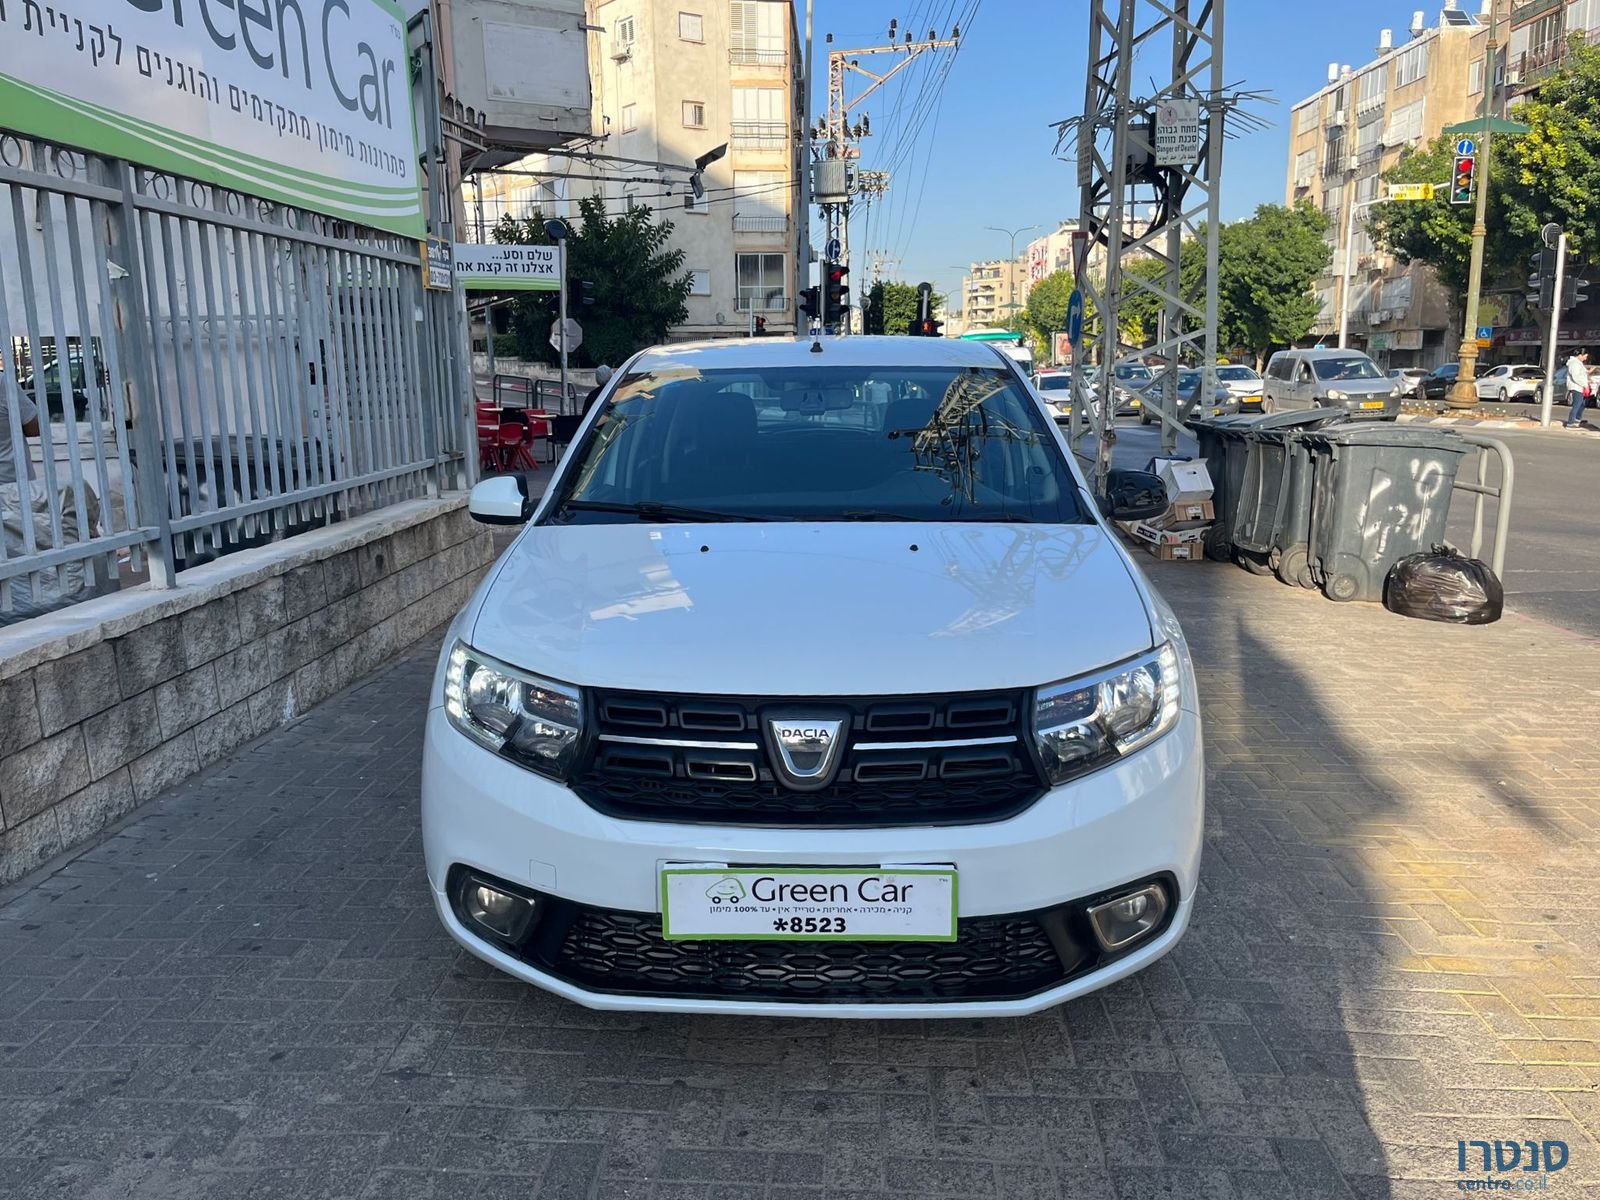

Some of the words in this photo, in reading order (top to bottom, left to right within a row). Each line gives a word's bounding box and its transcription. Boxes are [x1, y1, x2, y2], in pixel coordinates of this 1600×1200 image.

[23, 0, 122, 68] לקניית
[322, 0, 395, 130] Car
[136, 44, 220, 105] והוגנים
[228, 84, 311, 141] מתקדמים
[1180, 125, 1197, 134] מתח
[316, 122, 355, 158] מימון
[1178, 135, 1197, 144] סכנת
[1156, 145, 1174, 154] Danger
[1174, 144, 1180, 152] of
[358, 140, 406, 179] פתרונות
[491, 250, 524, 261] וסע...
[527, 248, 553, 261] שלם
[476, 262, 502, 275] קצת
[505, 263, 518, 273] זה
[521, 261, 554, 274] אצלנו
[781, 728, 830, 738] DACIA
[751, 877, 848, 903] Green
[857, 877, 914, 903] Car
[709, 906, 732, 914] מימון
[777, 906, 790, 915] אין
[822, 906, 853, 914] אחריות
[859, 906, 886, 914] מכירה
[892, 906, 913, 915] קניה
